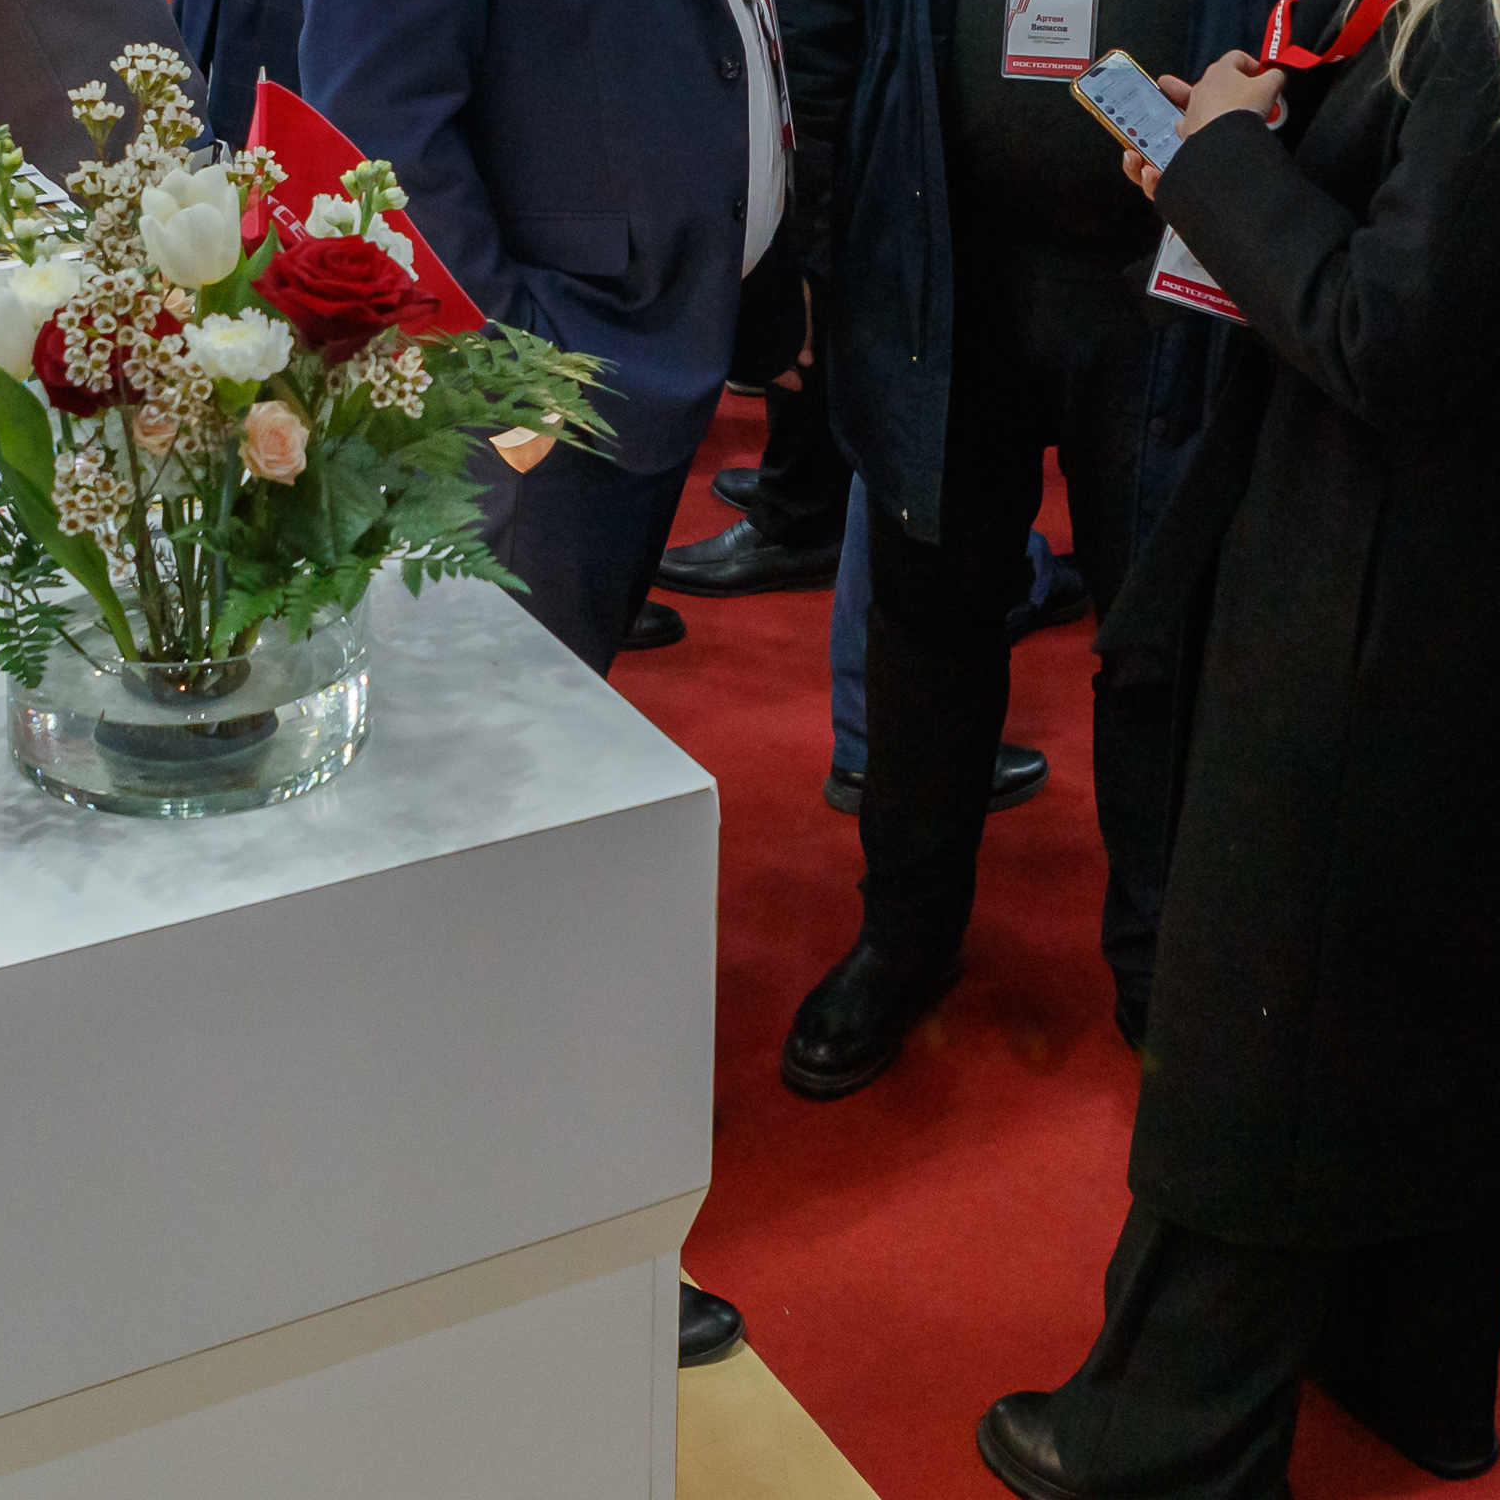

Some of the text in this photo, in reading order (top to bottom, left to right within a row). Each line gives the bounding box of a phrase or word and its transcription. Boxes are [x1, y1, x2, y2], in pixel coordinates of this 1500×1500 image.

[1035, 14, 1064, 23] Артем
[1012, 61, 1083, 71] РОСТСЕЛЬМАШ
[1161, 280, 1239, 310] РОСТСЕЛЬМА
